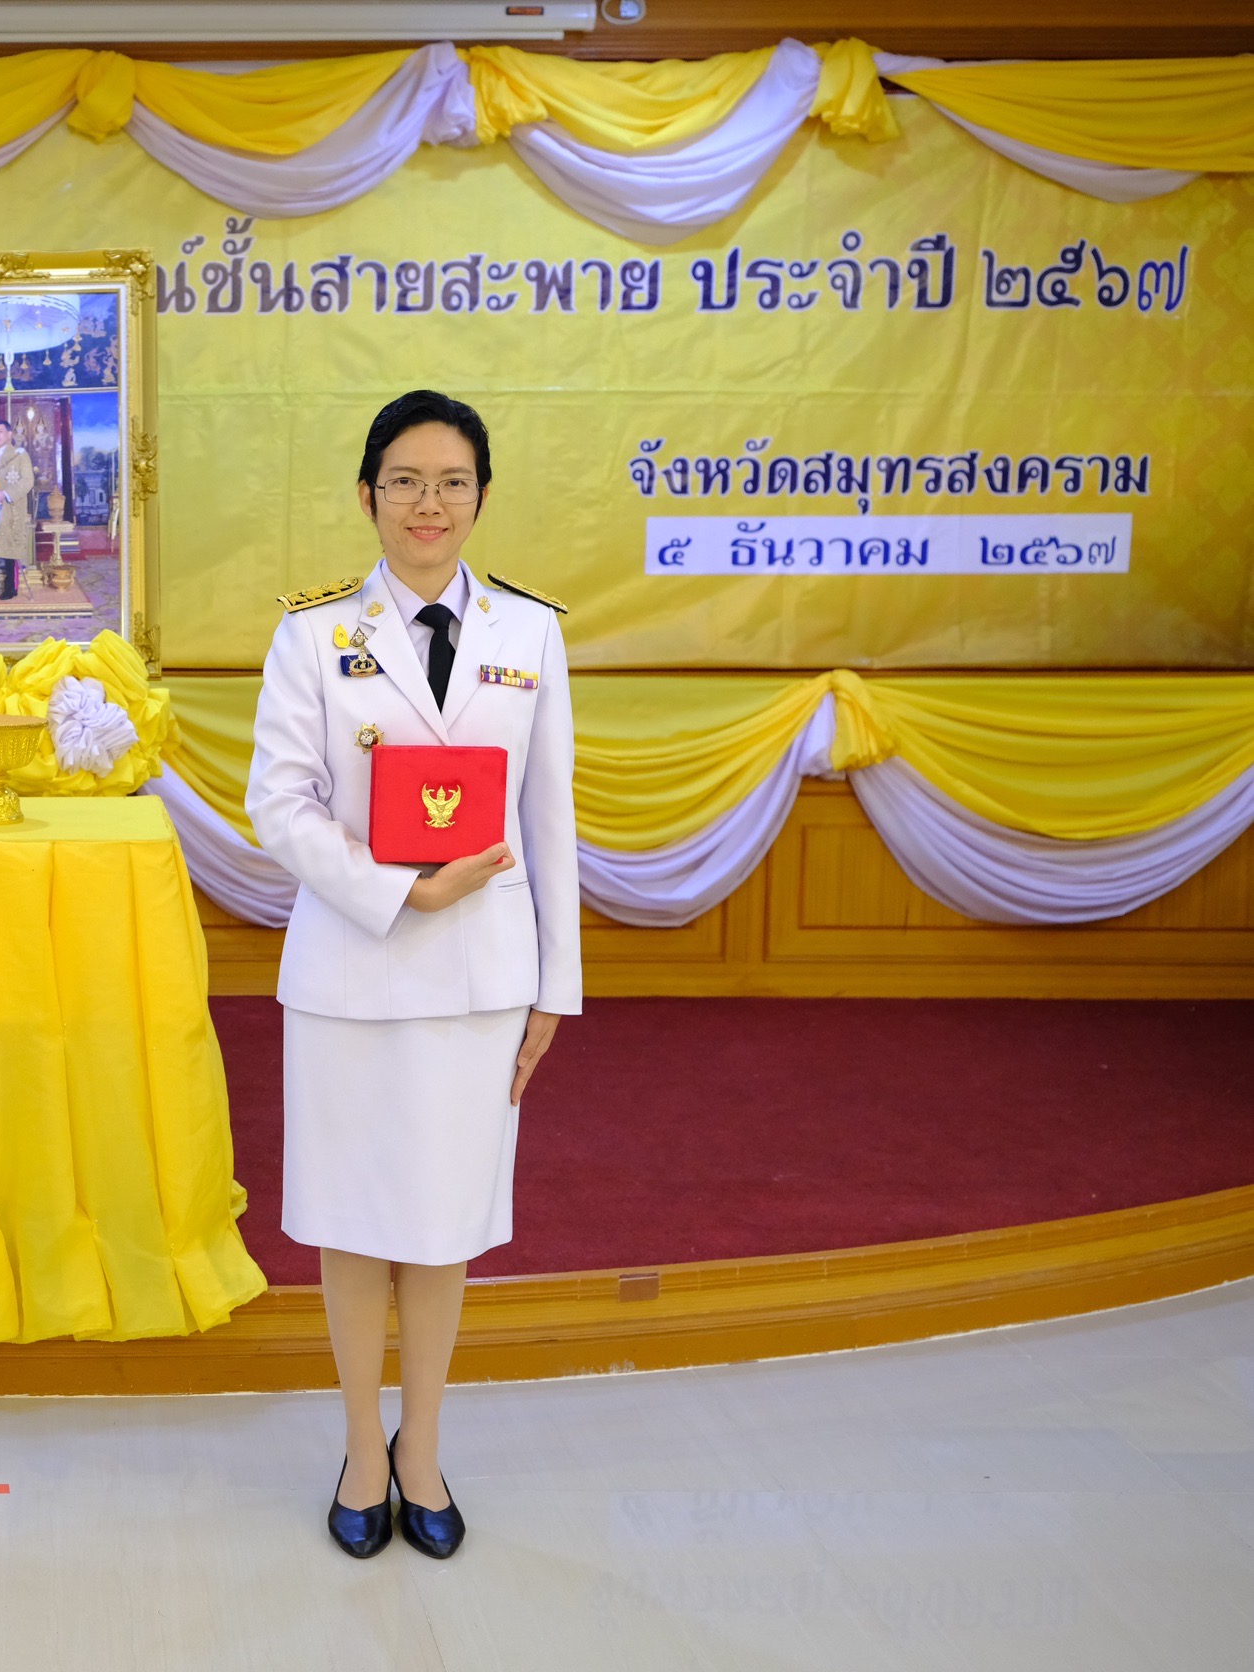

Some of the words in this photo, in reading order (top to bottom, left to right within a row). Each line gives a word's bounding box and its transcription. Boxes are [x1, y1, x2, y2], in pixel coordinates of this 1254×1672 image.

[692, 231, 955, 311] ประจำปี
[982, 239, 1189, 312] ๒๕๖๗
[629, 438, 1149, 515] จังหวัดสมุทรสงคราม
[657, 537, 692, 566] ๕
[730, 521, 930, 567] ธันวาคม
[979, 535, 1117, 566] ๒๕๖๗
